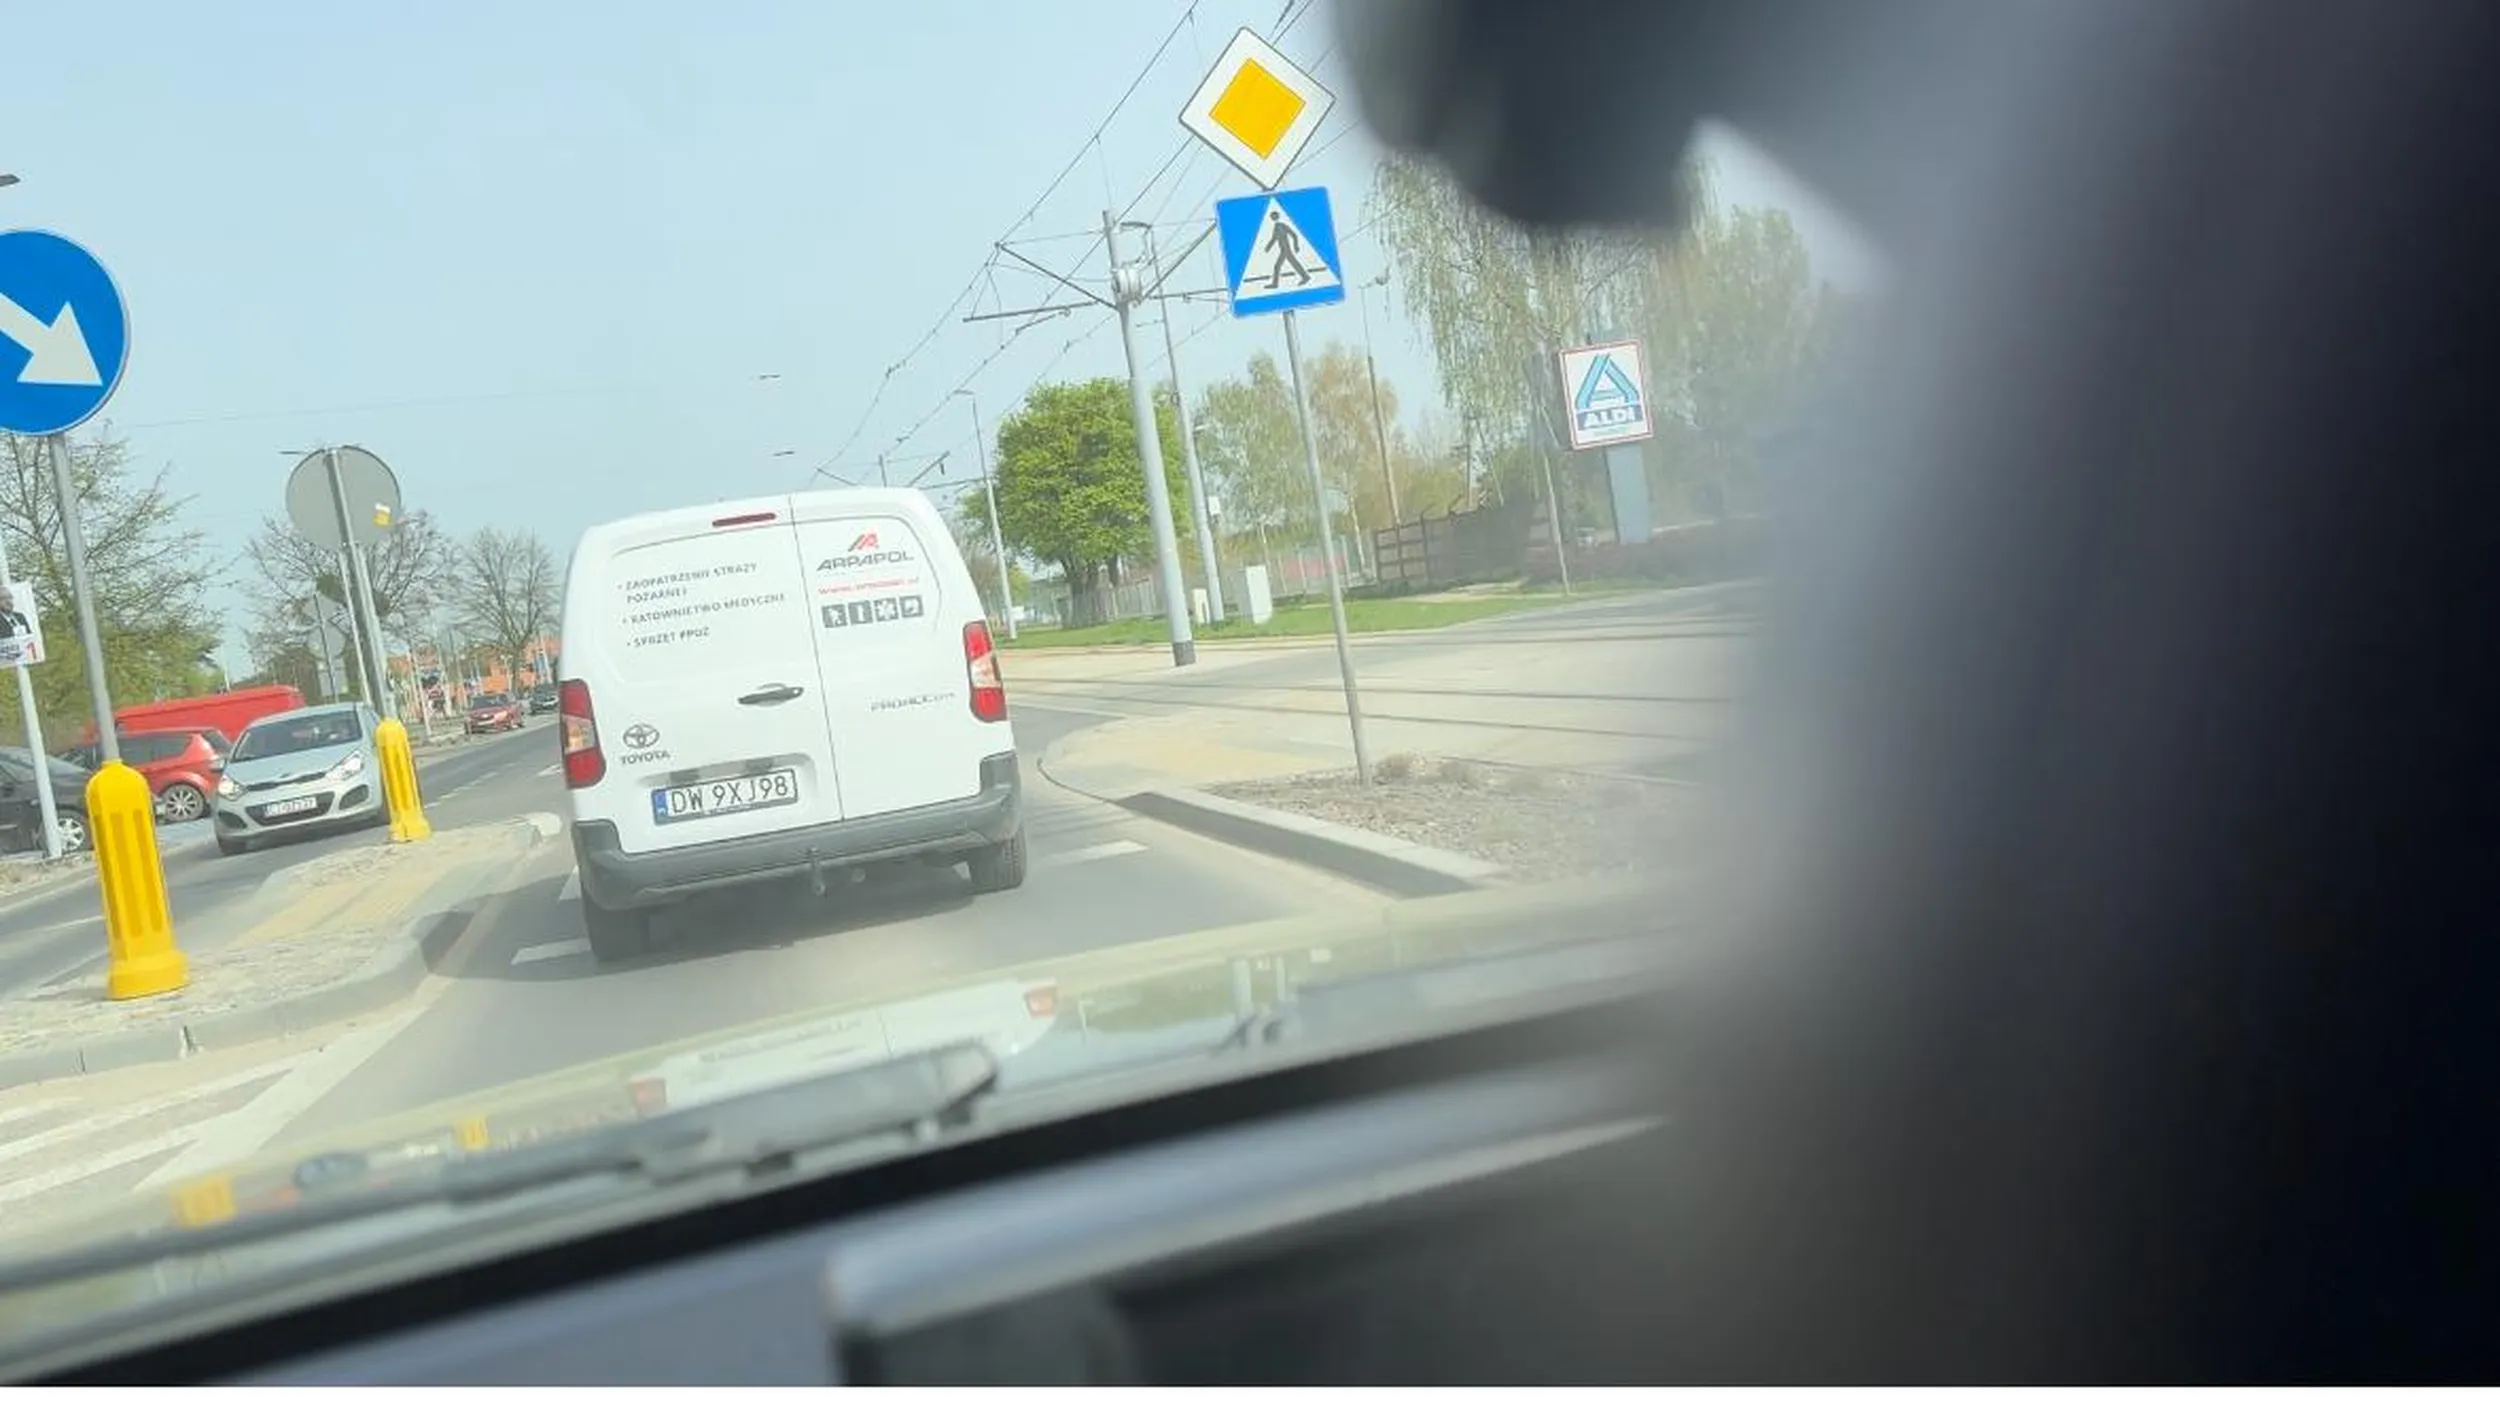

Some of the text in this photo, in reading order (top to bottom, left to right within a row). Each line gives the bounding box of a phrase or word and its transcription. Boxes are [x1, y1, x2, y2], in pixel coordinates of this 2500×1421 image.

[1584, 407, 1636, 428] ALDI
[816, 550, 915, 572] ARPAPOL
[620, 750, 671, 766] TOYOTA
[671, 786, 703, 814] DW
